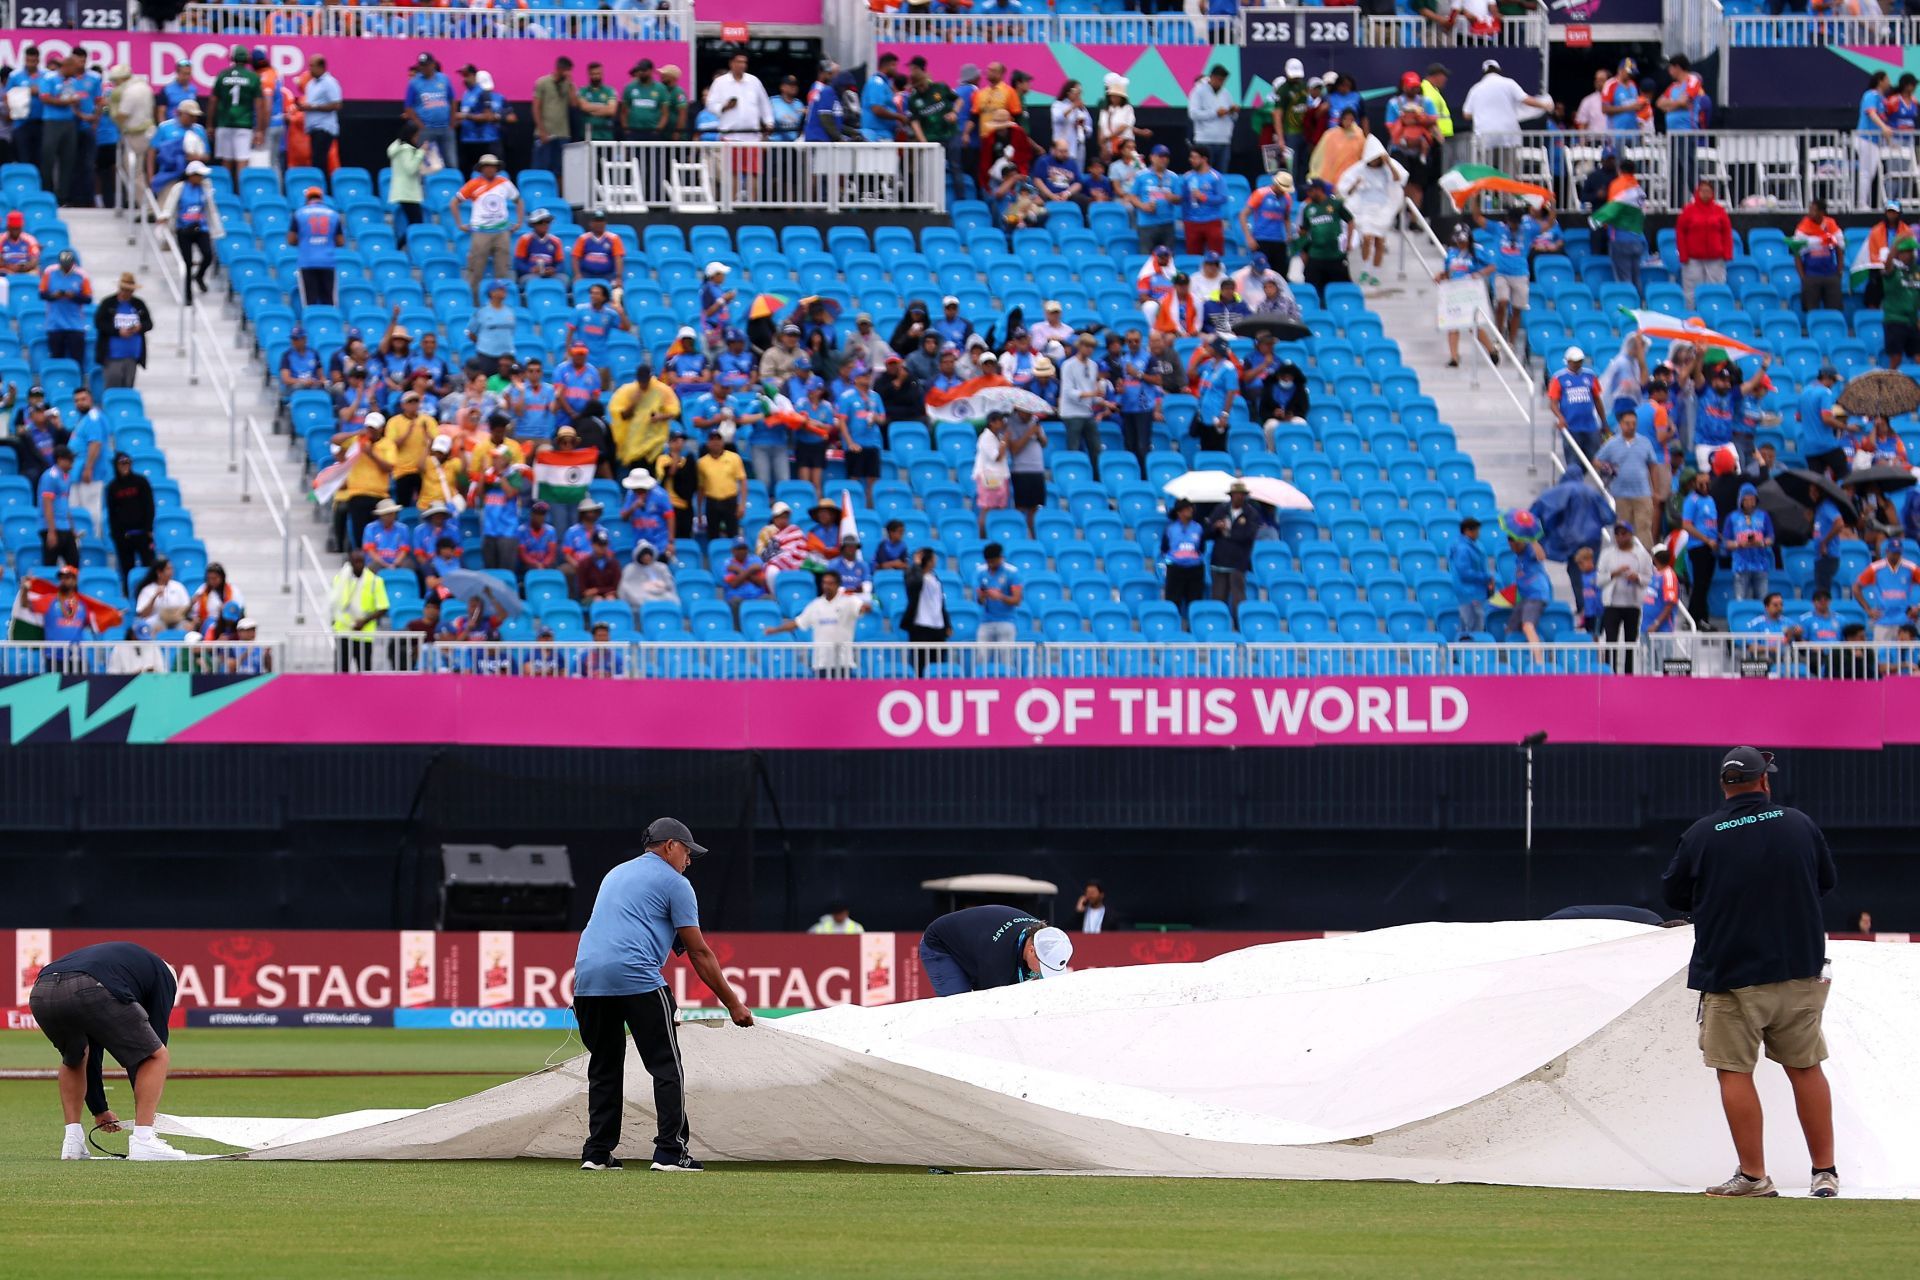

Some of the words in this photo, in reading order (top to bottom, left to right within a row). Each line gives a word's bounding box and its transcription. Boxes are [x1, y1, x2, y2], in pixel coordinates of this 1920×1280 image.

[21, 8, 62, 27] 224
[82, 9, 122, 28] 225
[1251, 22, 1291, 41] 225
[1310, 22, 1349, 41] 226
[229, 84, 240, 105] 1
[877, 689, 1000, 738] OUT
[1014, 687, 1096, 735] OF
[1109, 688, 1238, 735] THIS
[1251, 685, 1469, 735] WORLD
[1715, 815, 1757, 831] GROUND
[1757, 809, 1785, 822] STAFF
[992, 921, 1013, 942] STAFF
[256, 964, 392, 1008] STAG
[718, 966, 852, 1009] STAG
[450, 1010, 546, 1028] aramco
